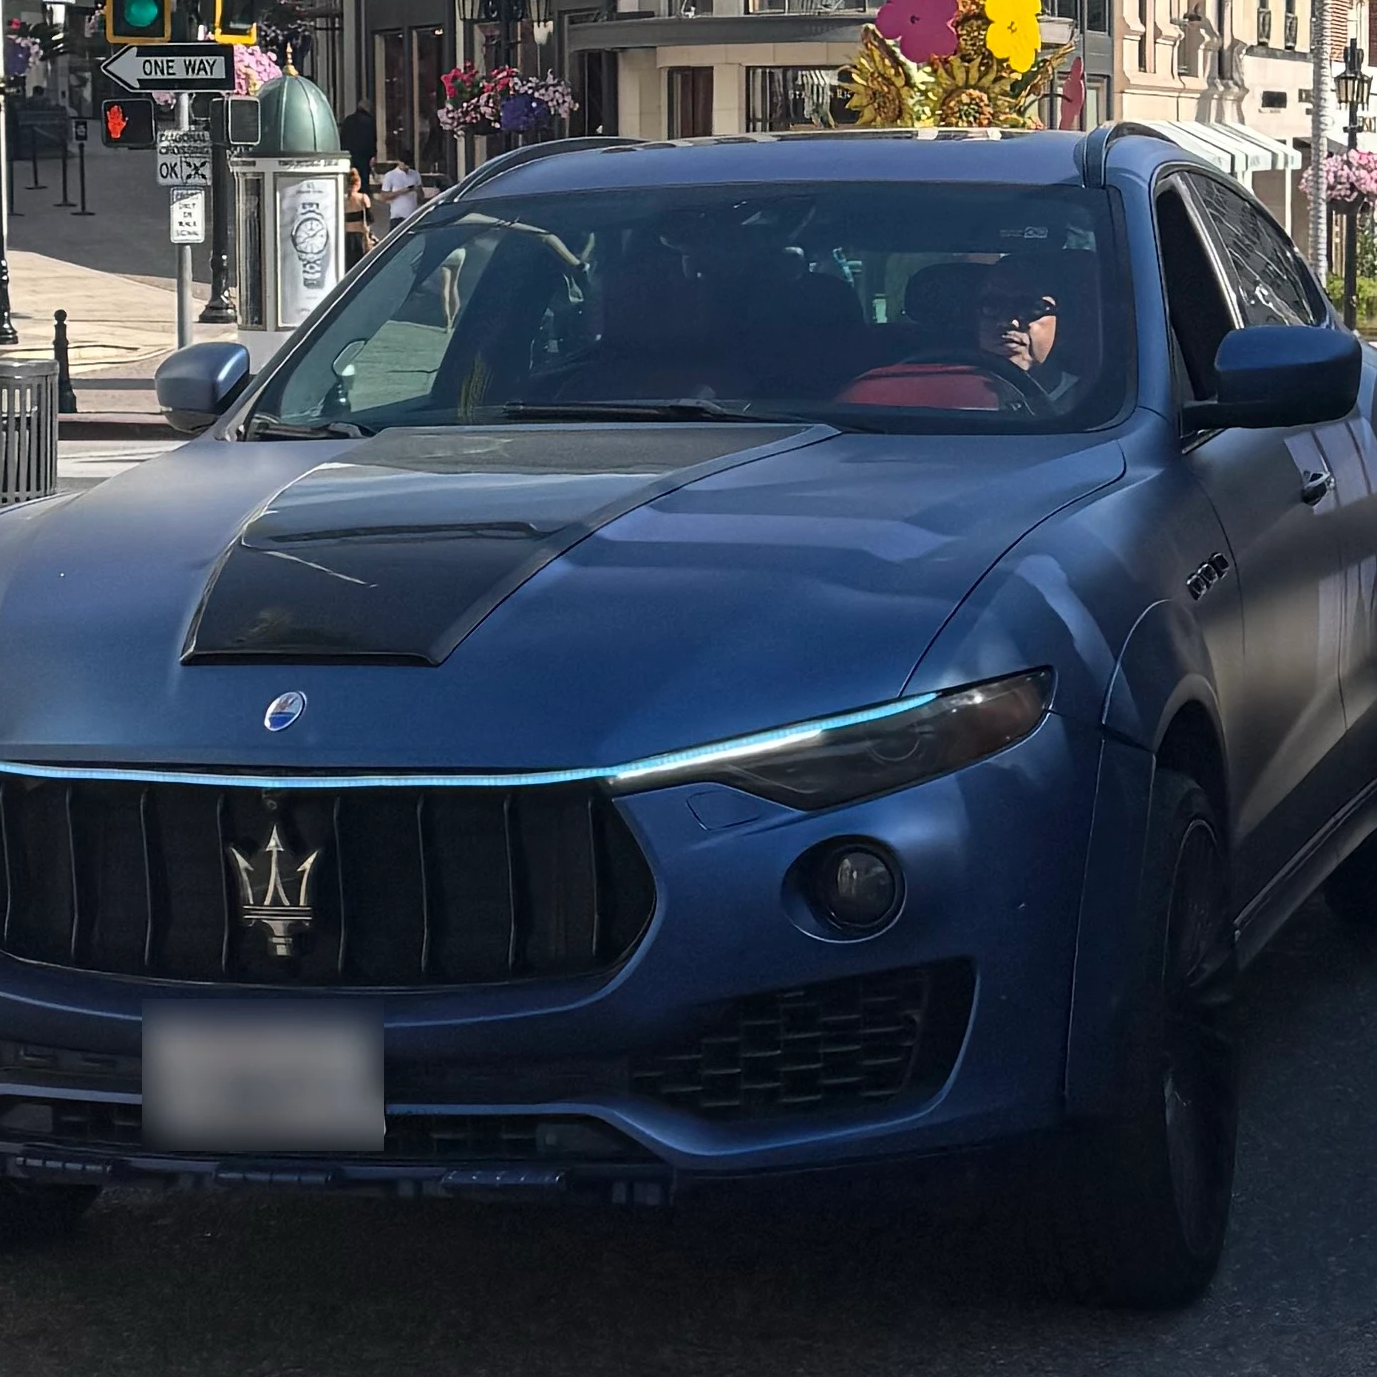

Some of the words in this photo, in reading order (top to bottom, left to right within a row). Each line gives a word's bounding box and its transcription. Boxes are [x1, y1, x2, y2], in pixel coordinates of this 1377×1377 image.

[142, 59, 176, 76] ONE
[184, 58, 217, 76] WAY
[159, 162, 179, 179] OK
